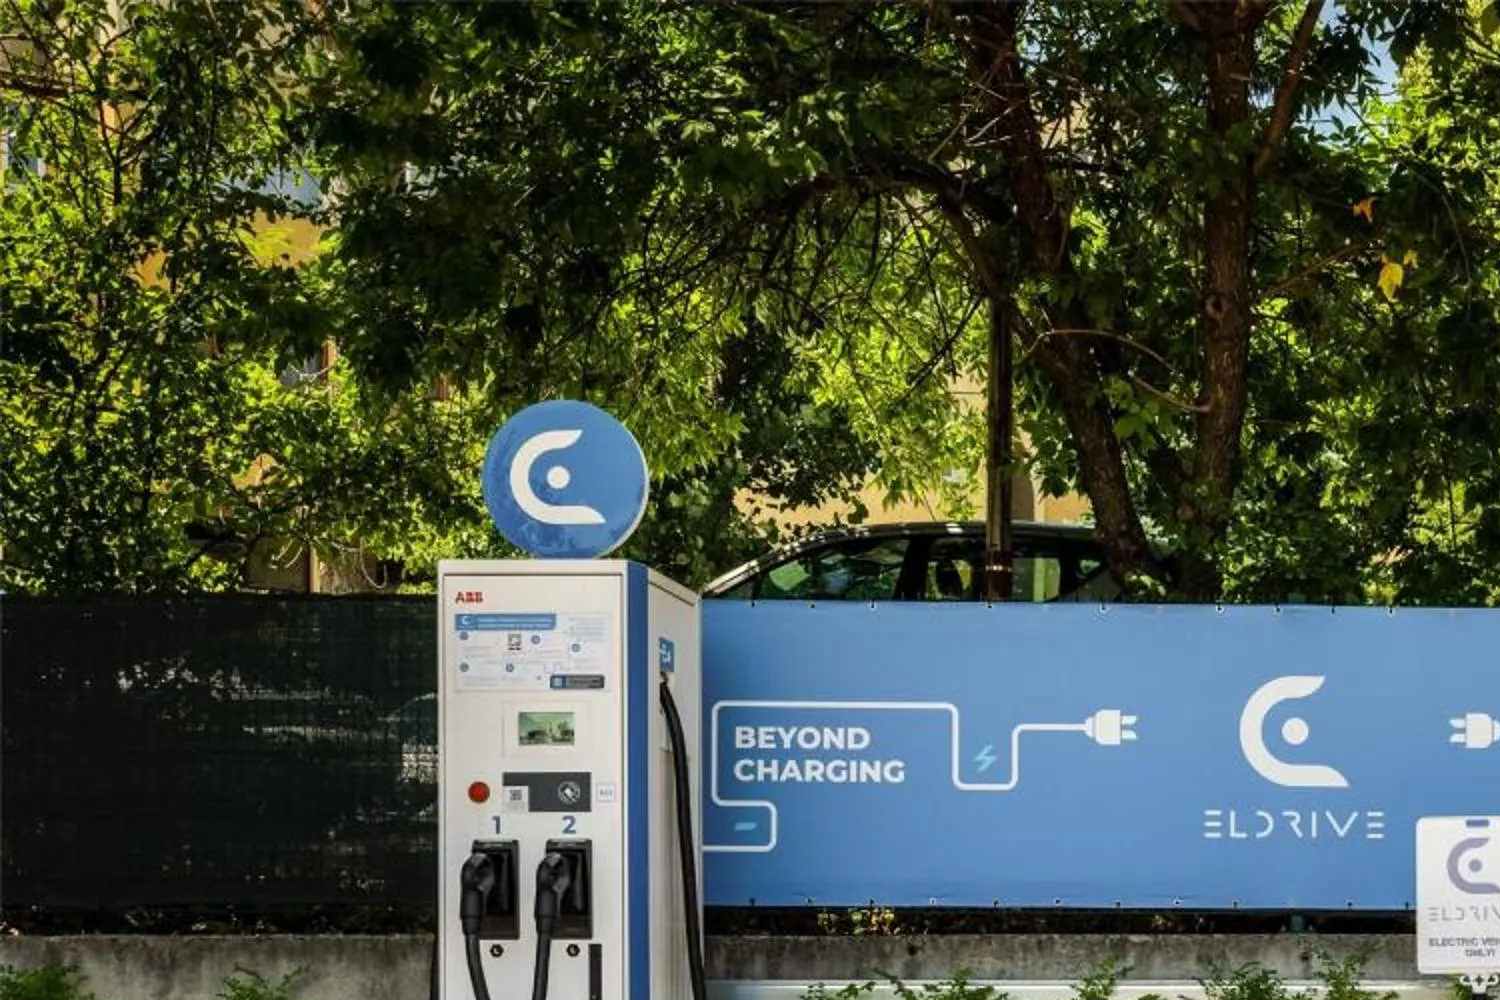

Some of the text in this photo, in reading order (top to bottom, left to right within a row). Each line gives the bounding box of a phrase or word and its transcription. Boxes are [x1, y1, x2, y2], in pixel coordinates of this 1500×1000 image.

[455, 591, 484, 604] ABB
[733, 726, 871, 750] BEYOND
[733, 758, 906, 784] CHARGING
[491, 815, 502, 835] 1
[561, 815, 577, 835] 2
[1203, 809, 1385, 839] ELDRIVE
[1429, 937, 1479, 947] ELECTRIC
